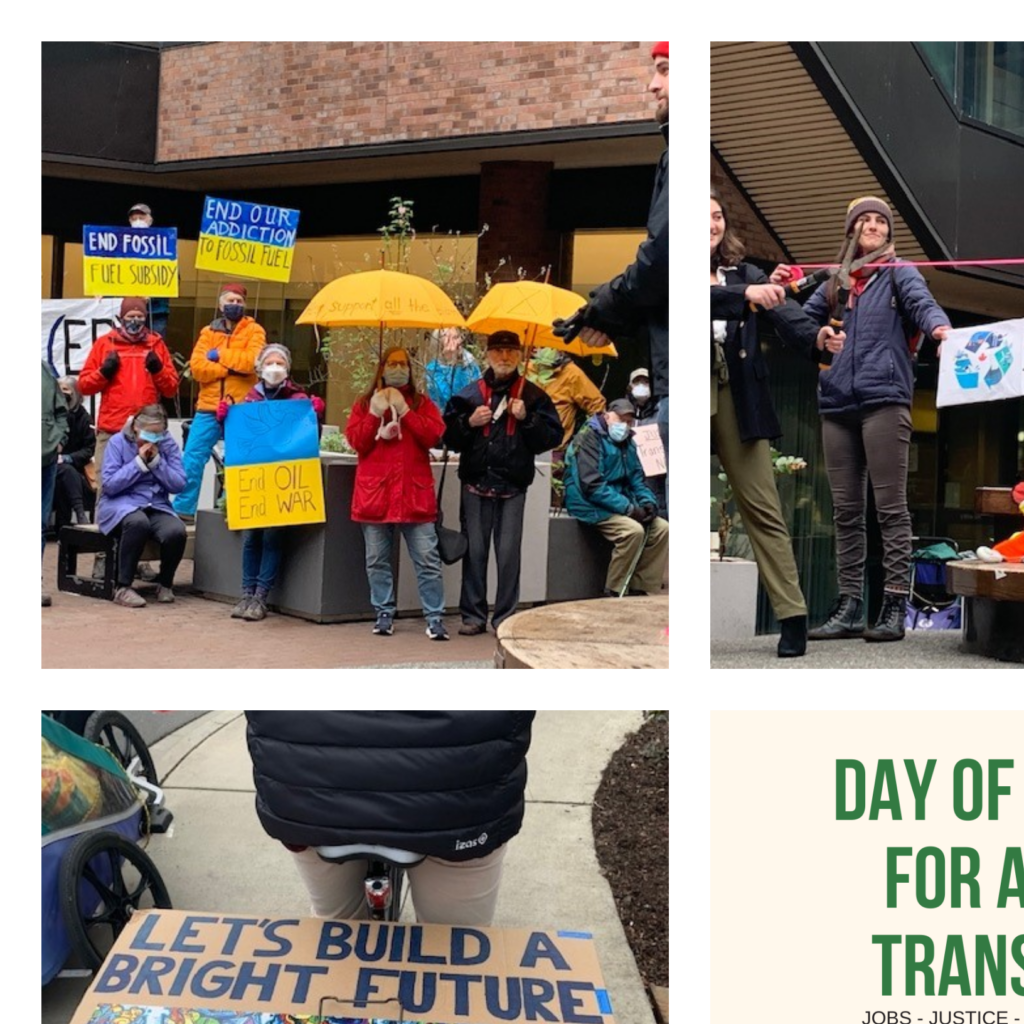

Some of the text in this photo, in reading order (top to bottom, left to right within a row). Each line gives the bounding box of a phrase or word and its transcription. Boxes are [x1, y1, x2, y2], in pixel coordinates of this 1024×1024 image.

[206, 199, 292, 226] END OUR
[89, 232, 173, 256] END FOSSIL
[206, 220, 296, 248] ADDICTION
[200, 236, 289, 269] TO FOSSIL FUEL
[90, 263, 177, 288] FUEL SUBSIDY
[239, 465, 310, 492] End OIL
[239, 490, 317, 520] End WAR
[836, 759, 938, 821] DAY
[953, 758, 1014, 821] OF
[455, 839, 478, 851] izas
[887, 846, 981, 909] FOR
[130, 914, 573, 971] LET'S BUILD A
[93, 953, 604, 1024] BRIGHT FUTURE
